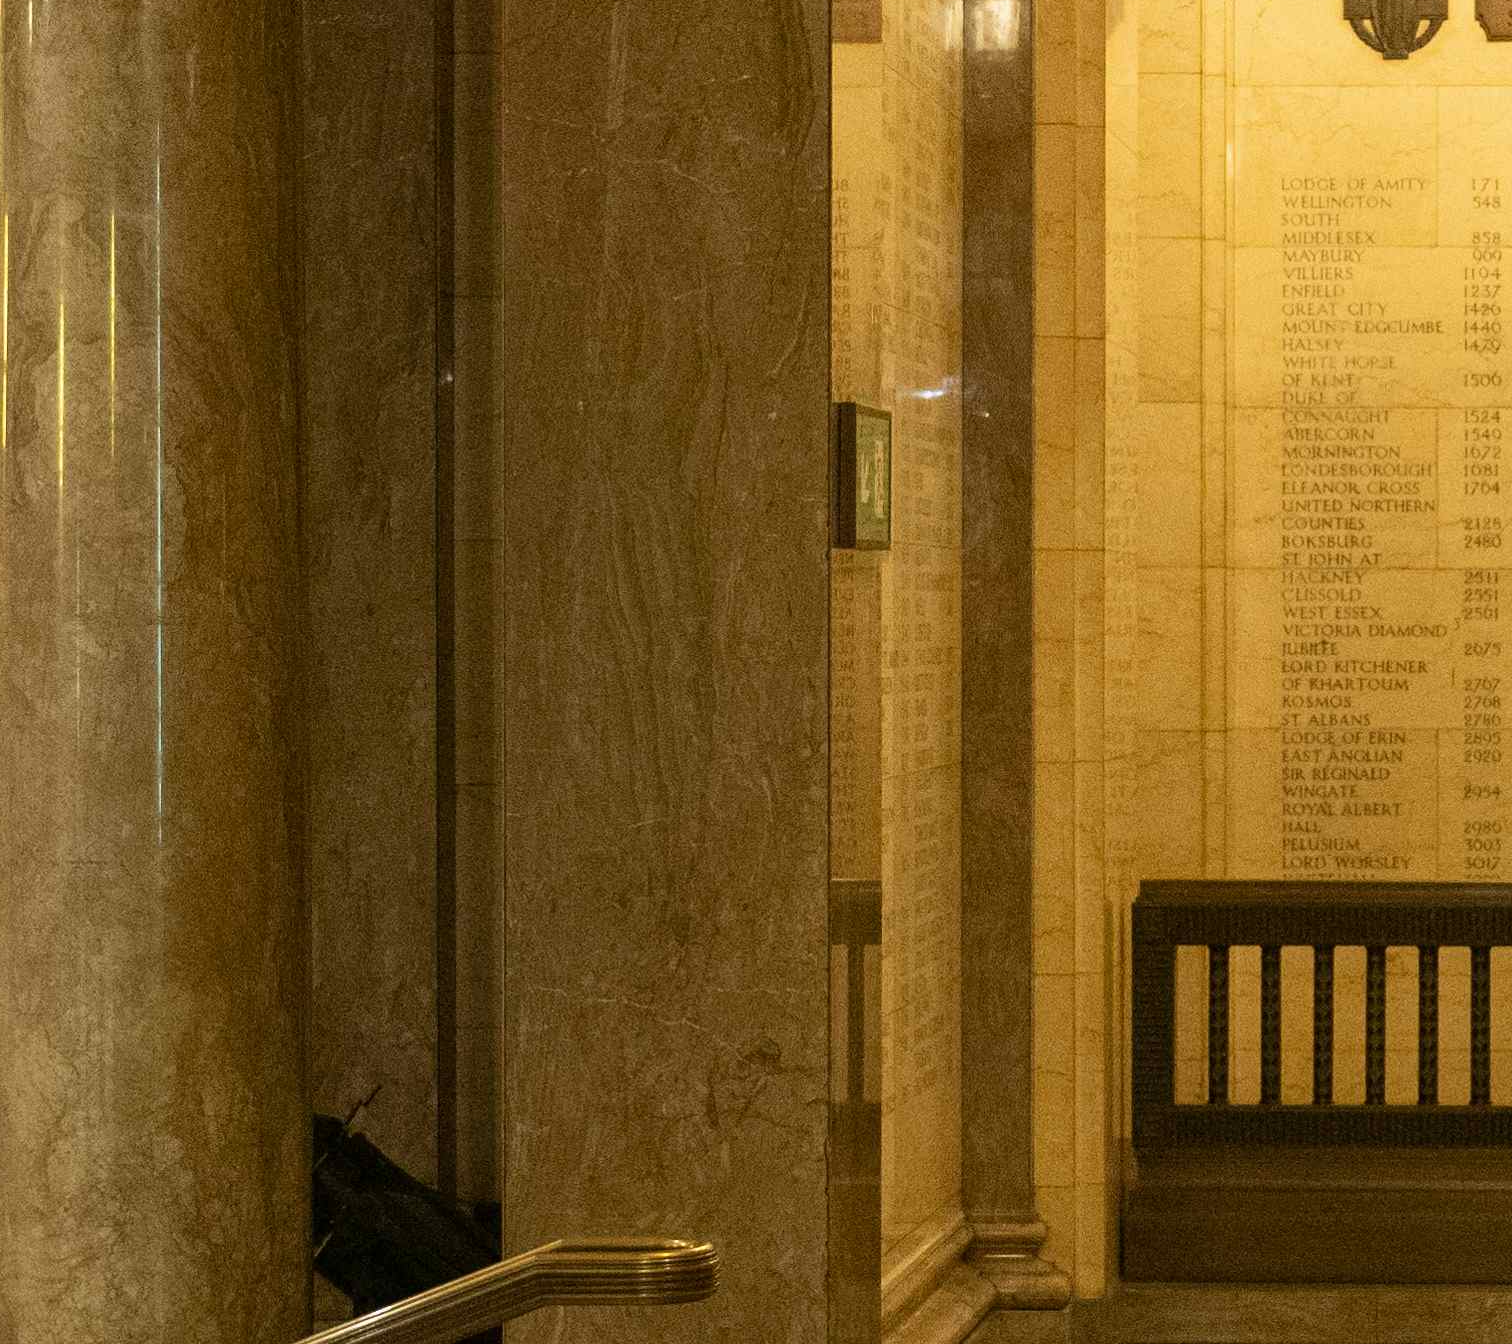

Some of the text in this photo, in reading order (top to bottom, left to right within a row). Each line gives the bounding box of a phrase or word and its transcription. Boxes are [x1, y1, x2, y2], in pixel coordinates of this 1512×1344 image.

[1281, 178, 1337, 191] LODGE
[1347, 178, 1366, 191] OF
[1374, 178, 1427, 191] AMITY
[1284, 196, 1392, 209] WELLINGTON
[1282, 231, 1376, 244] MIDDLESEX
